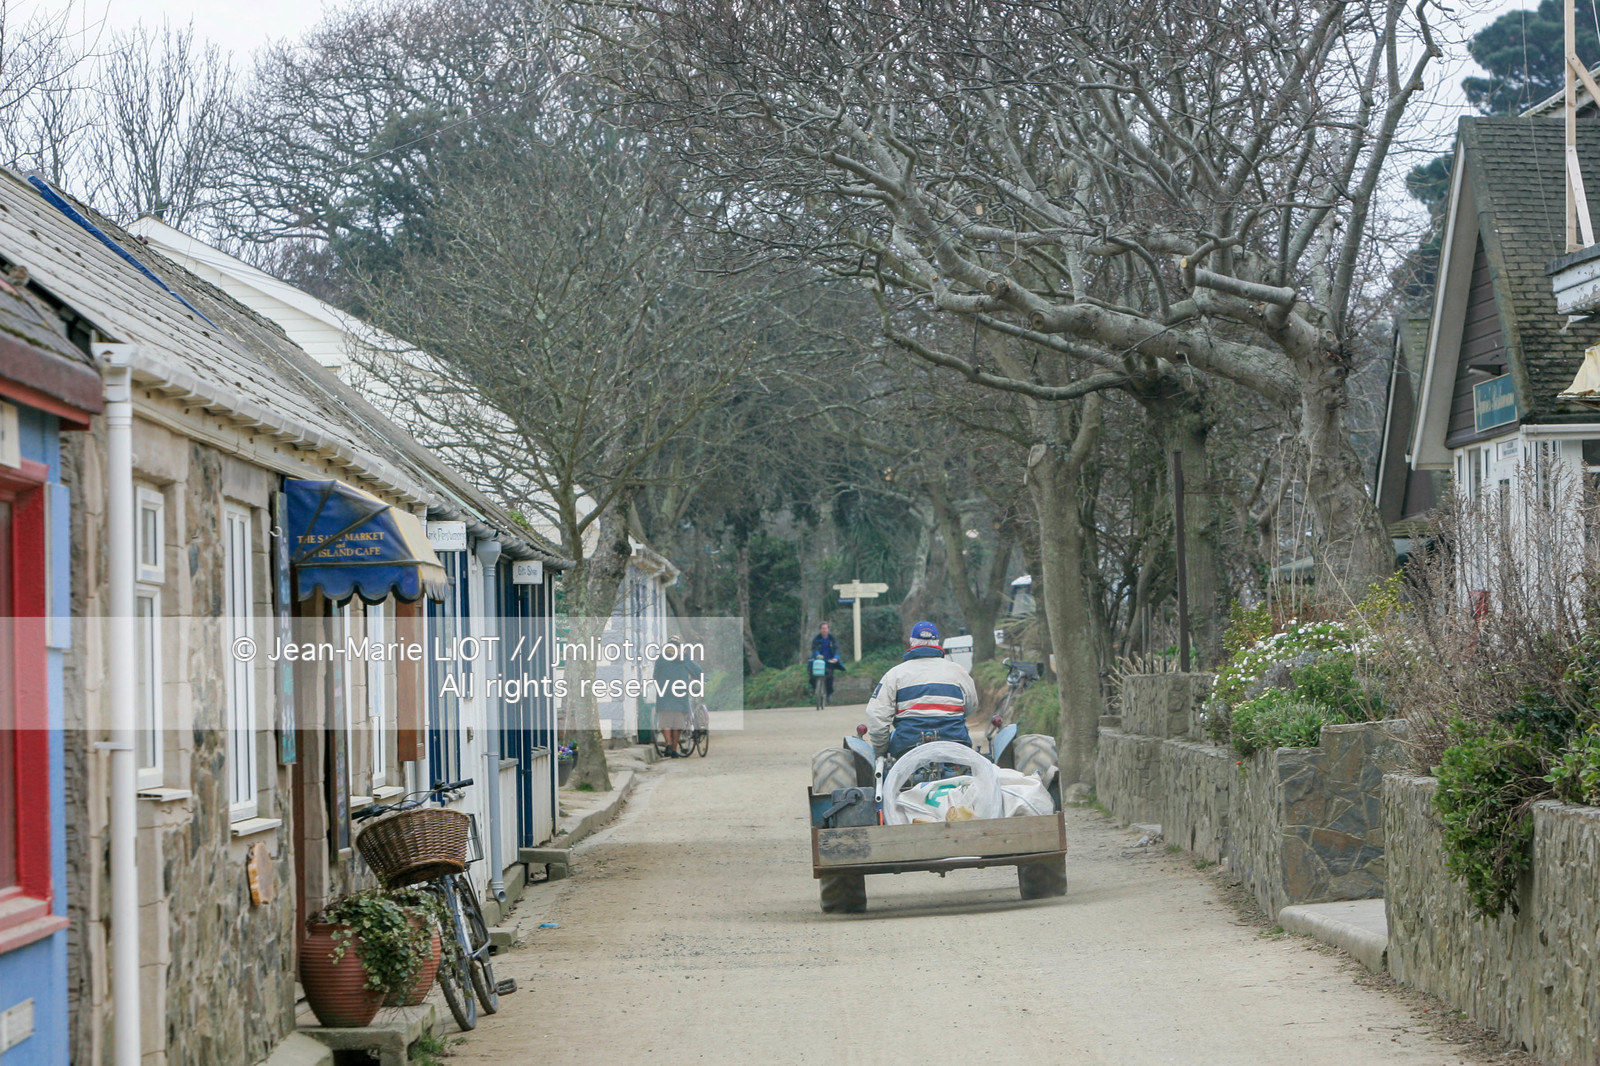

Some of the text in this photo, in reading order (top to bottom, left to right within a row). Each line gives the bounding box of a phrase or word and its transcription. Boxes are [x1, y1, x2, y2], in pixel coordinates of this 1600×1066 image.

[345, 532, 385, 541] MARKET
[318, 548, 354, 558] ISLAND
[355, 546, 381, 556] CAFE
